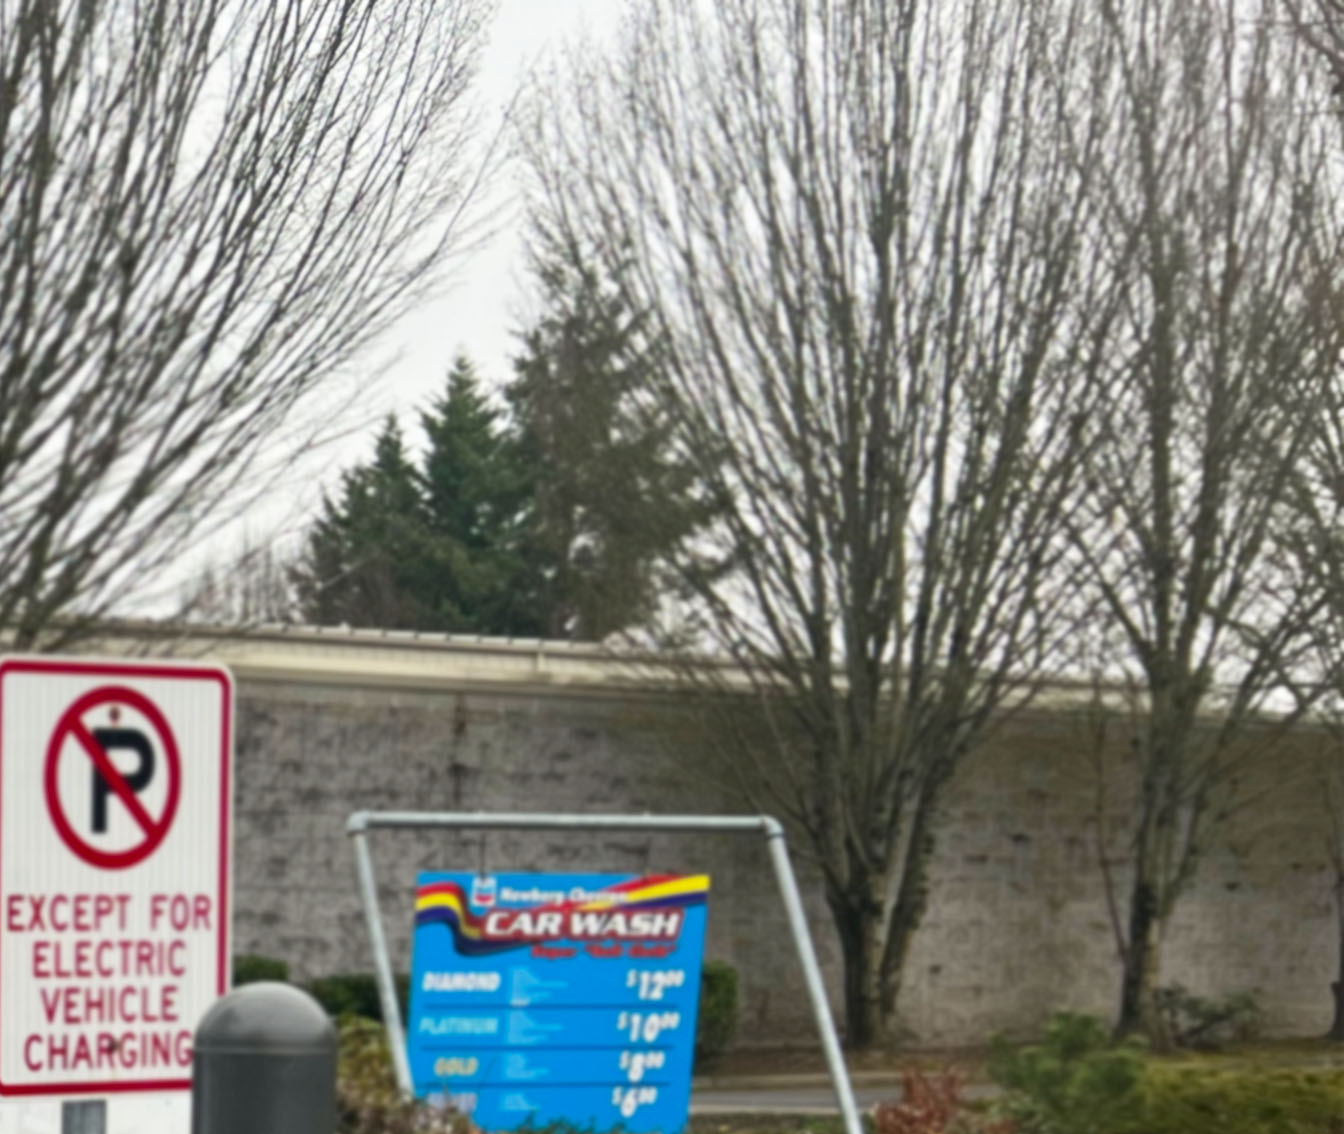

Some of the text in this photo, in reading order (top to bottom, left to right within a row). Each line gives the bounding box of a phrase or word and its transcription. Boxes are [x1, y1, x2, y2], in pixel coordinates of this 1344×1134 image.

[7, 894, 211, 932] EXCEPT FOR
[485, 911, 681, 937] CAR WASH
[33, 940, 186, 979] ELECTRIC
[422, 971, 502, 992] DIAMOND
[41, 985, 179, 1024] VEHICLE
[24, 1031, 193, 1072] CHARGING
